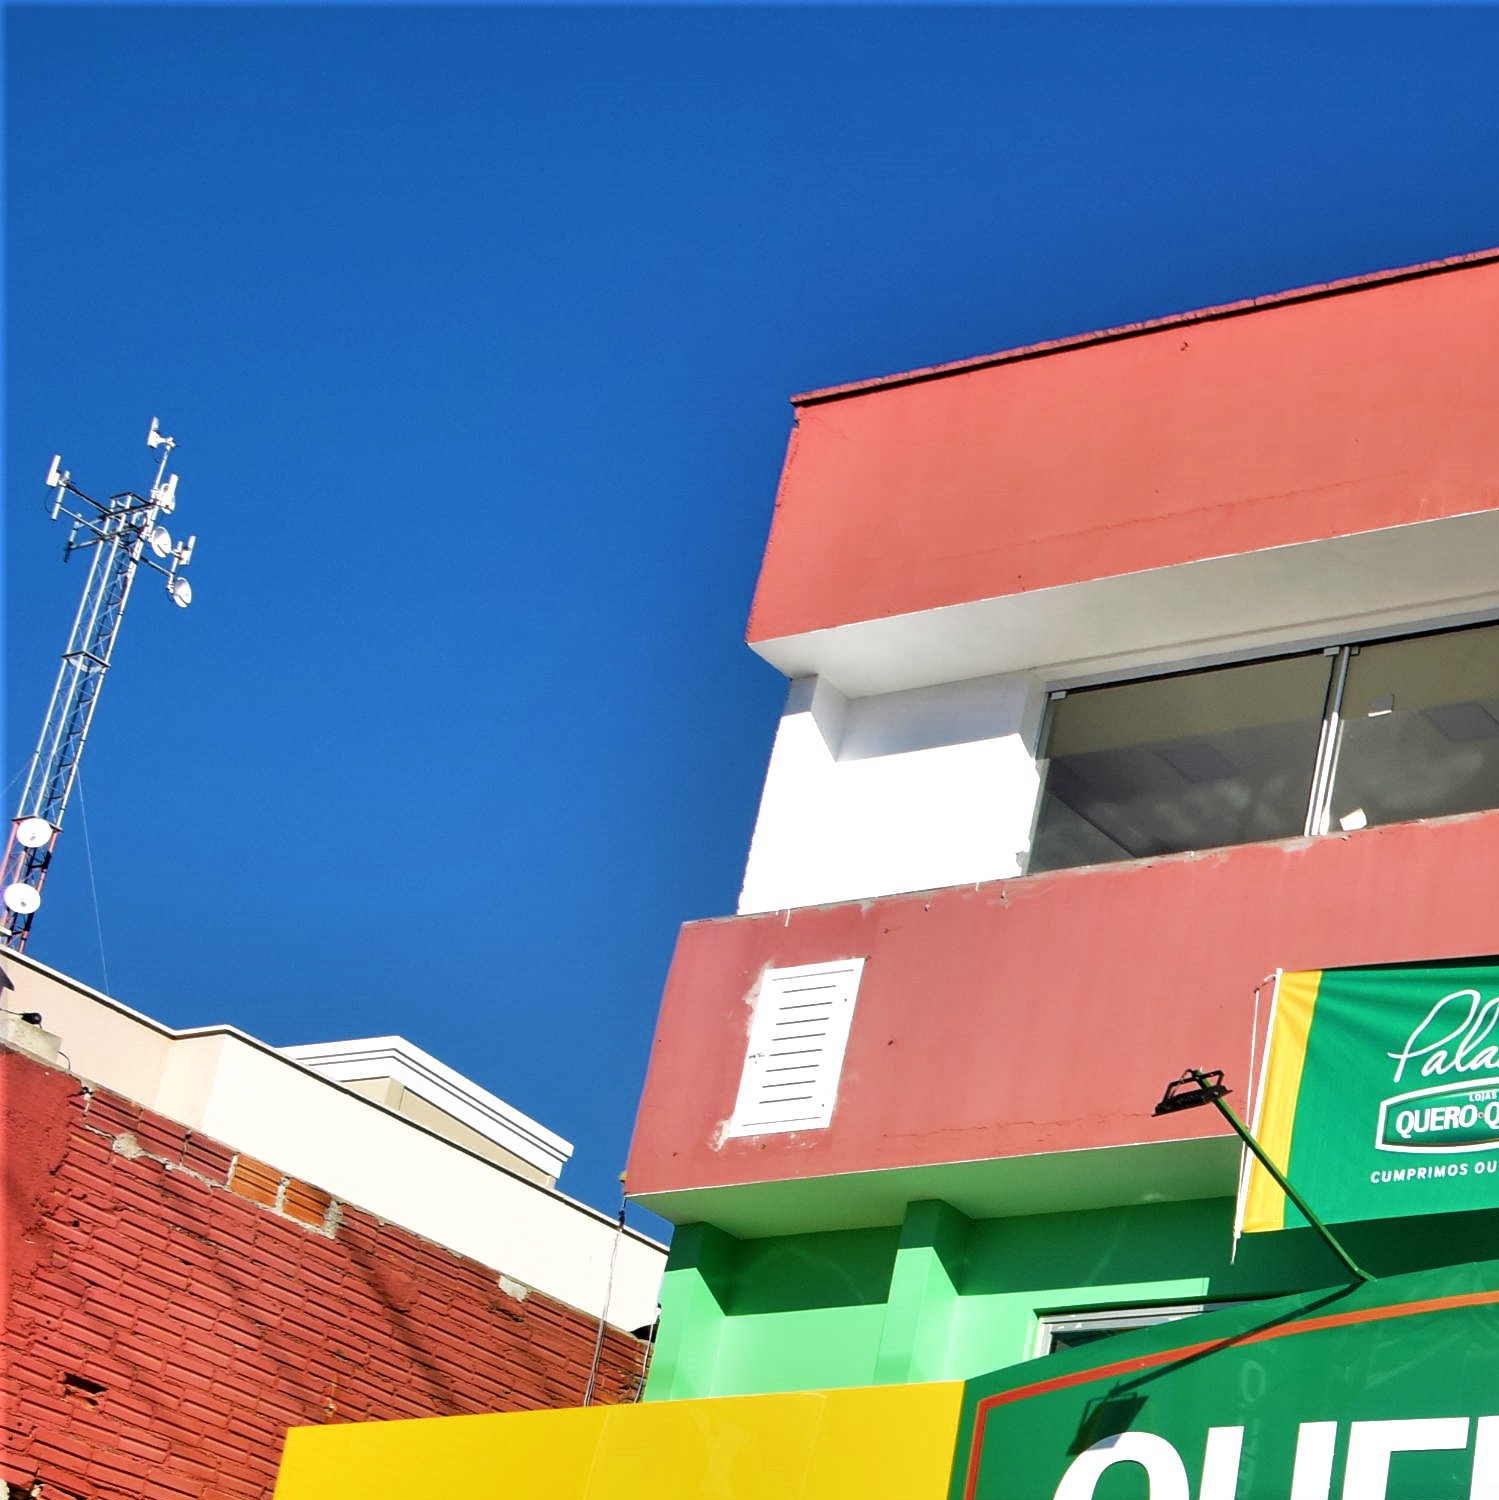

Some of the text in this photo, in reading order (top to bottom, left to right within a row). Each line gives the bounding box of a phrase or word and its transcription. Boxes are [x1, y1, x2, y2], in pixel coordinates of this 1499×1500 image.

[1468, 1090, 1498, 1102] LOJAS
[1370, 1163, 1468, 1183] CUMPRIMOS
[1475, 1161, 1497, 1174] OU
